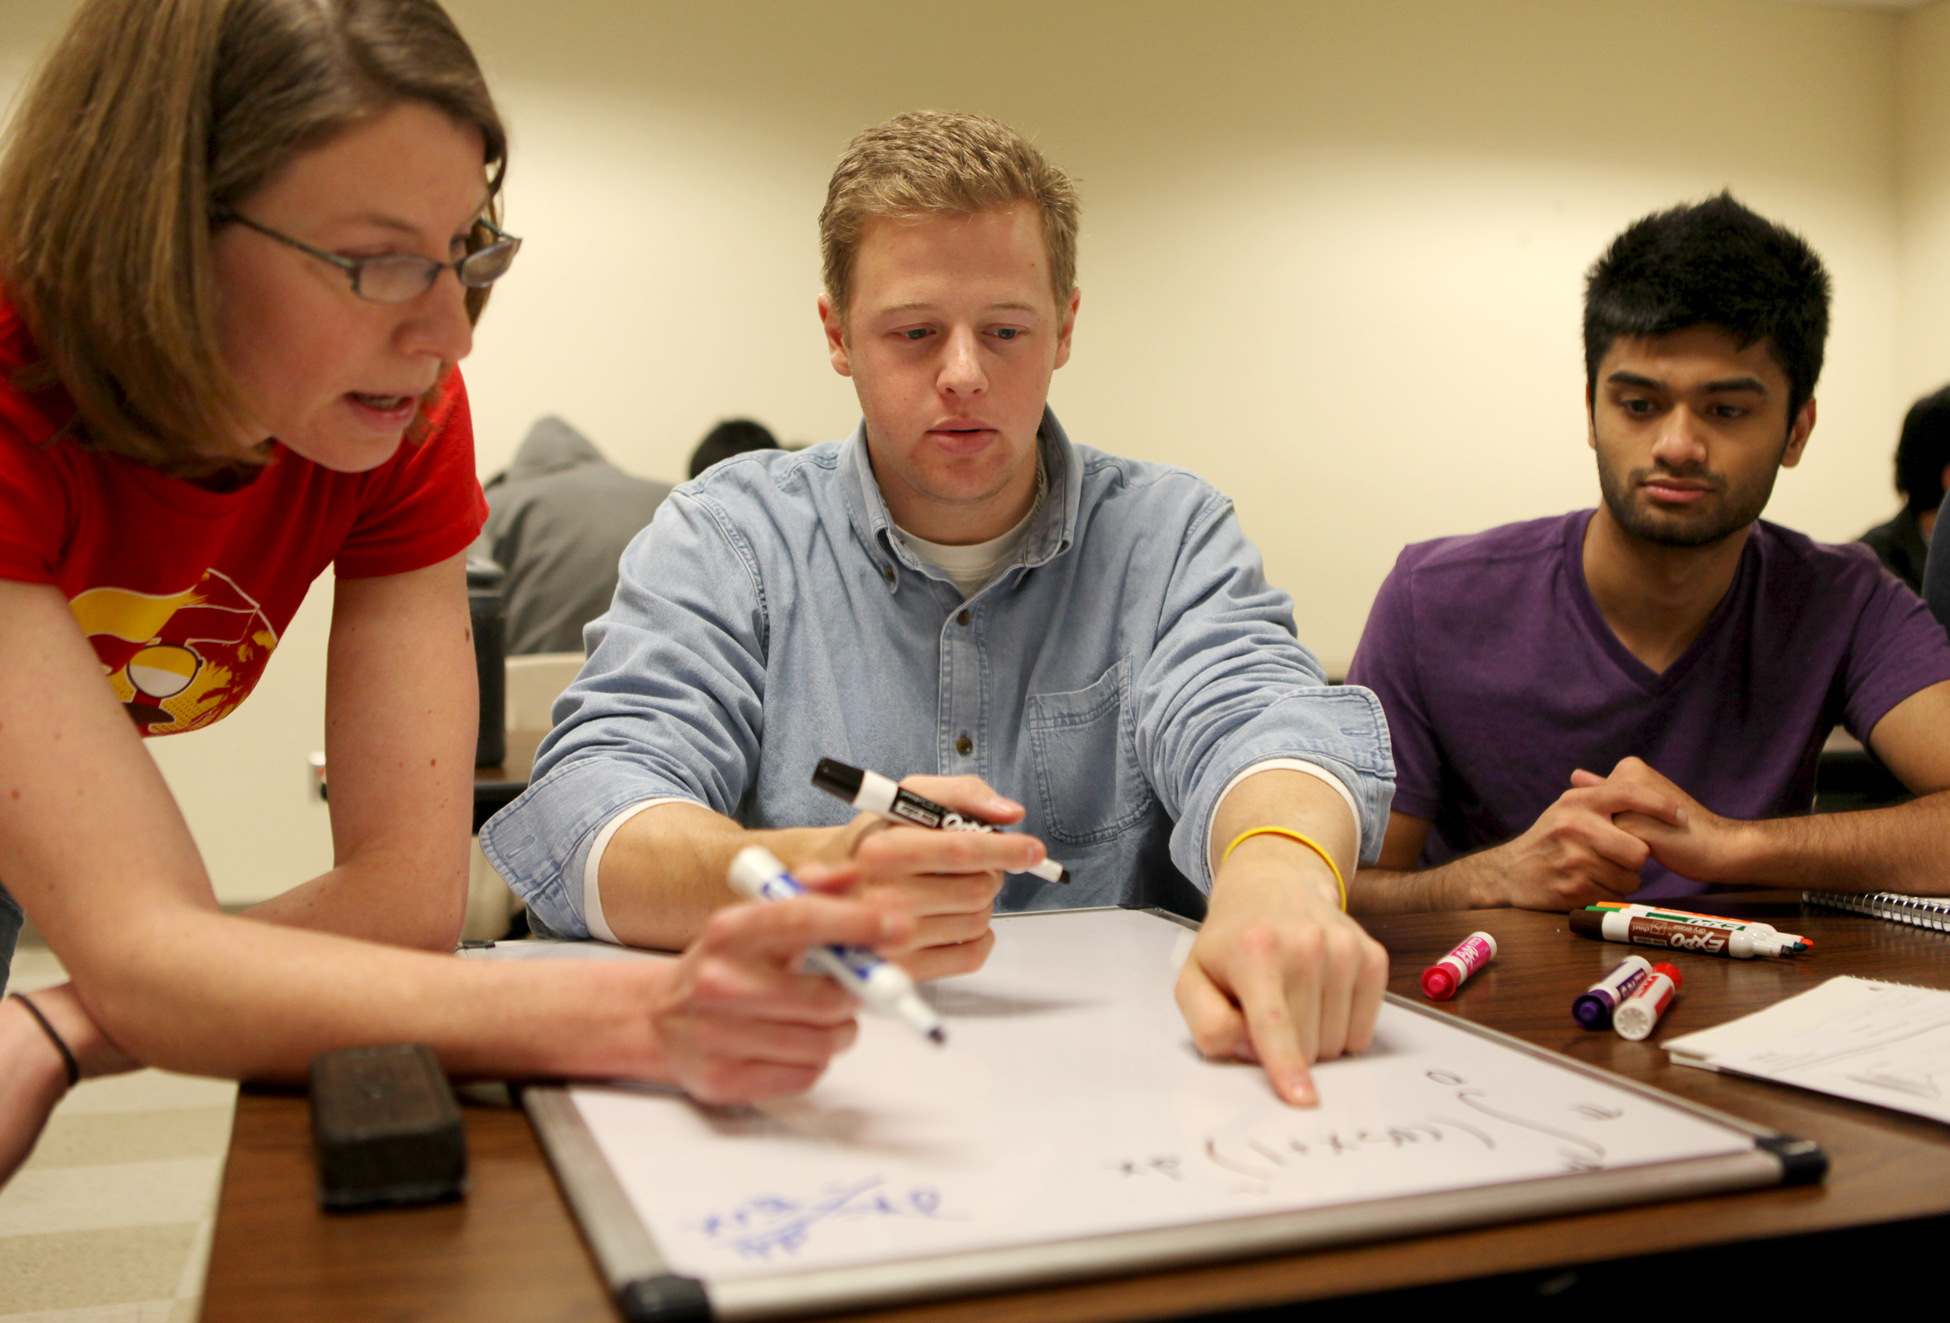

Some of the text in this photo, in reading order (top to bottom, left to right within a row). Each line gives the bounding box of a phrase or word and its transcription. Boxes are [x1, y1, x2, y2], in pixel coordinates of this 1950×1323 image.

[1632, 924, 1650, 933] chisel
[1672, 923, 1707, 935] dry erase
[1670, 931, 1725, 953] EXPO
